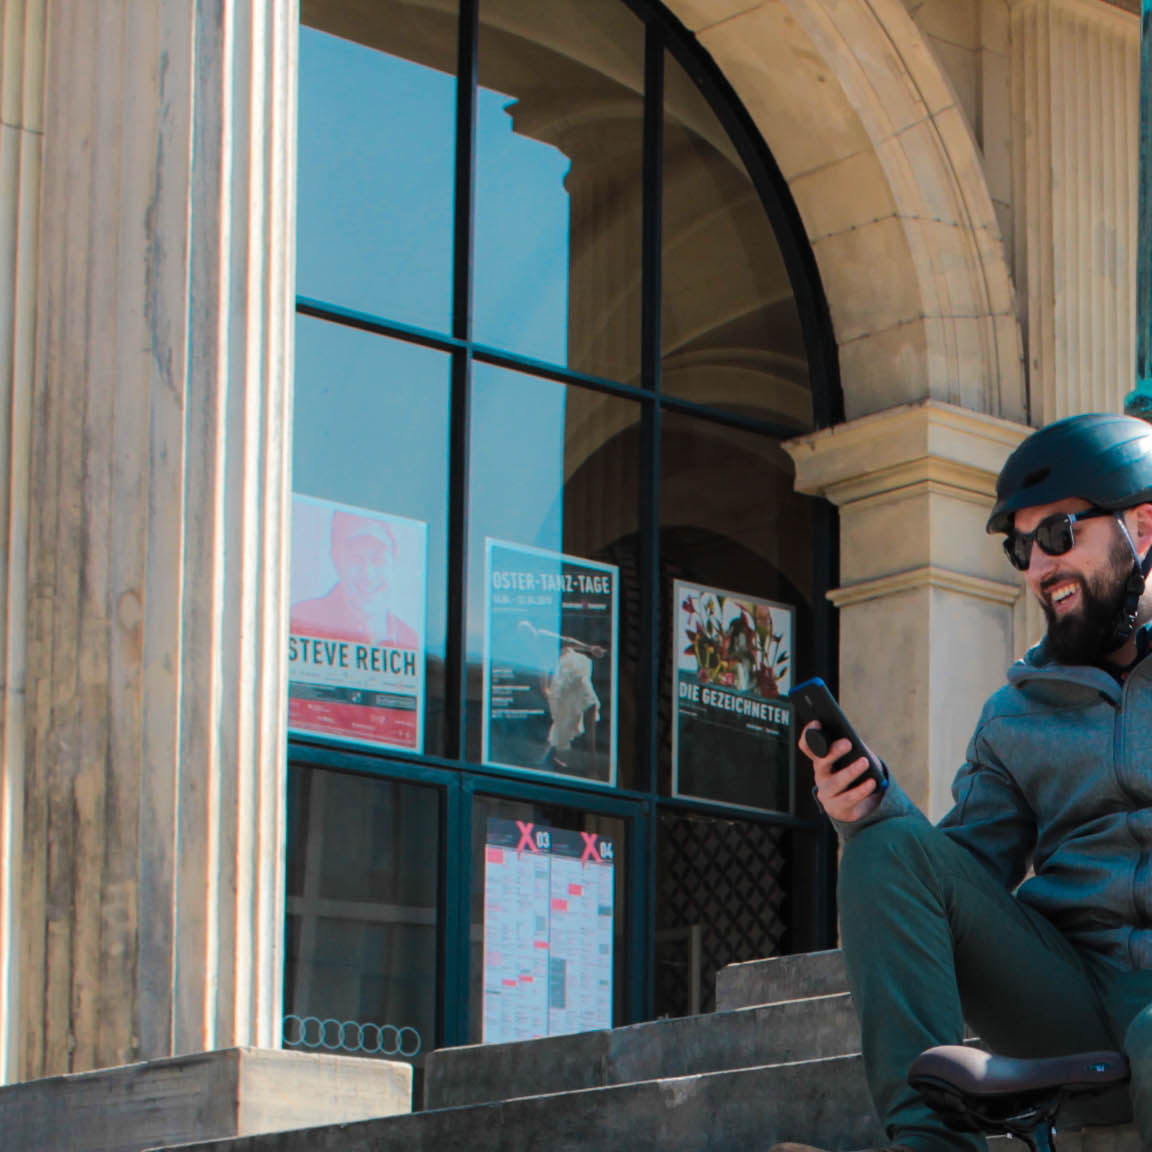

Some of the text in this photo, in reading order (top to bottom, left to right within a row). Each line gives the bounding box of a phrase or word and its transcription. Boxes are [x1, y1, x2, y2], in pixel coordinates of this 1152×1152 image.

[493, 571, 611, 594] OSTER-TANZ-TAGE
[288, 637, 417, 676] STEVE REICH
[679, 681, 790, 726] DIE GEZEICHNETEN
[536, 831, 551, 849] 03
[600, 841, 615, 859] 04
